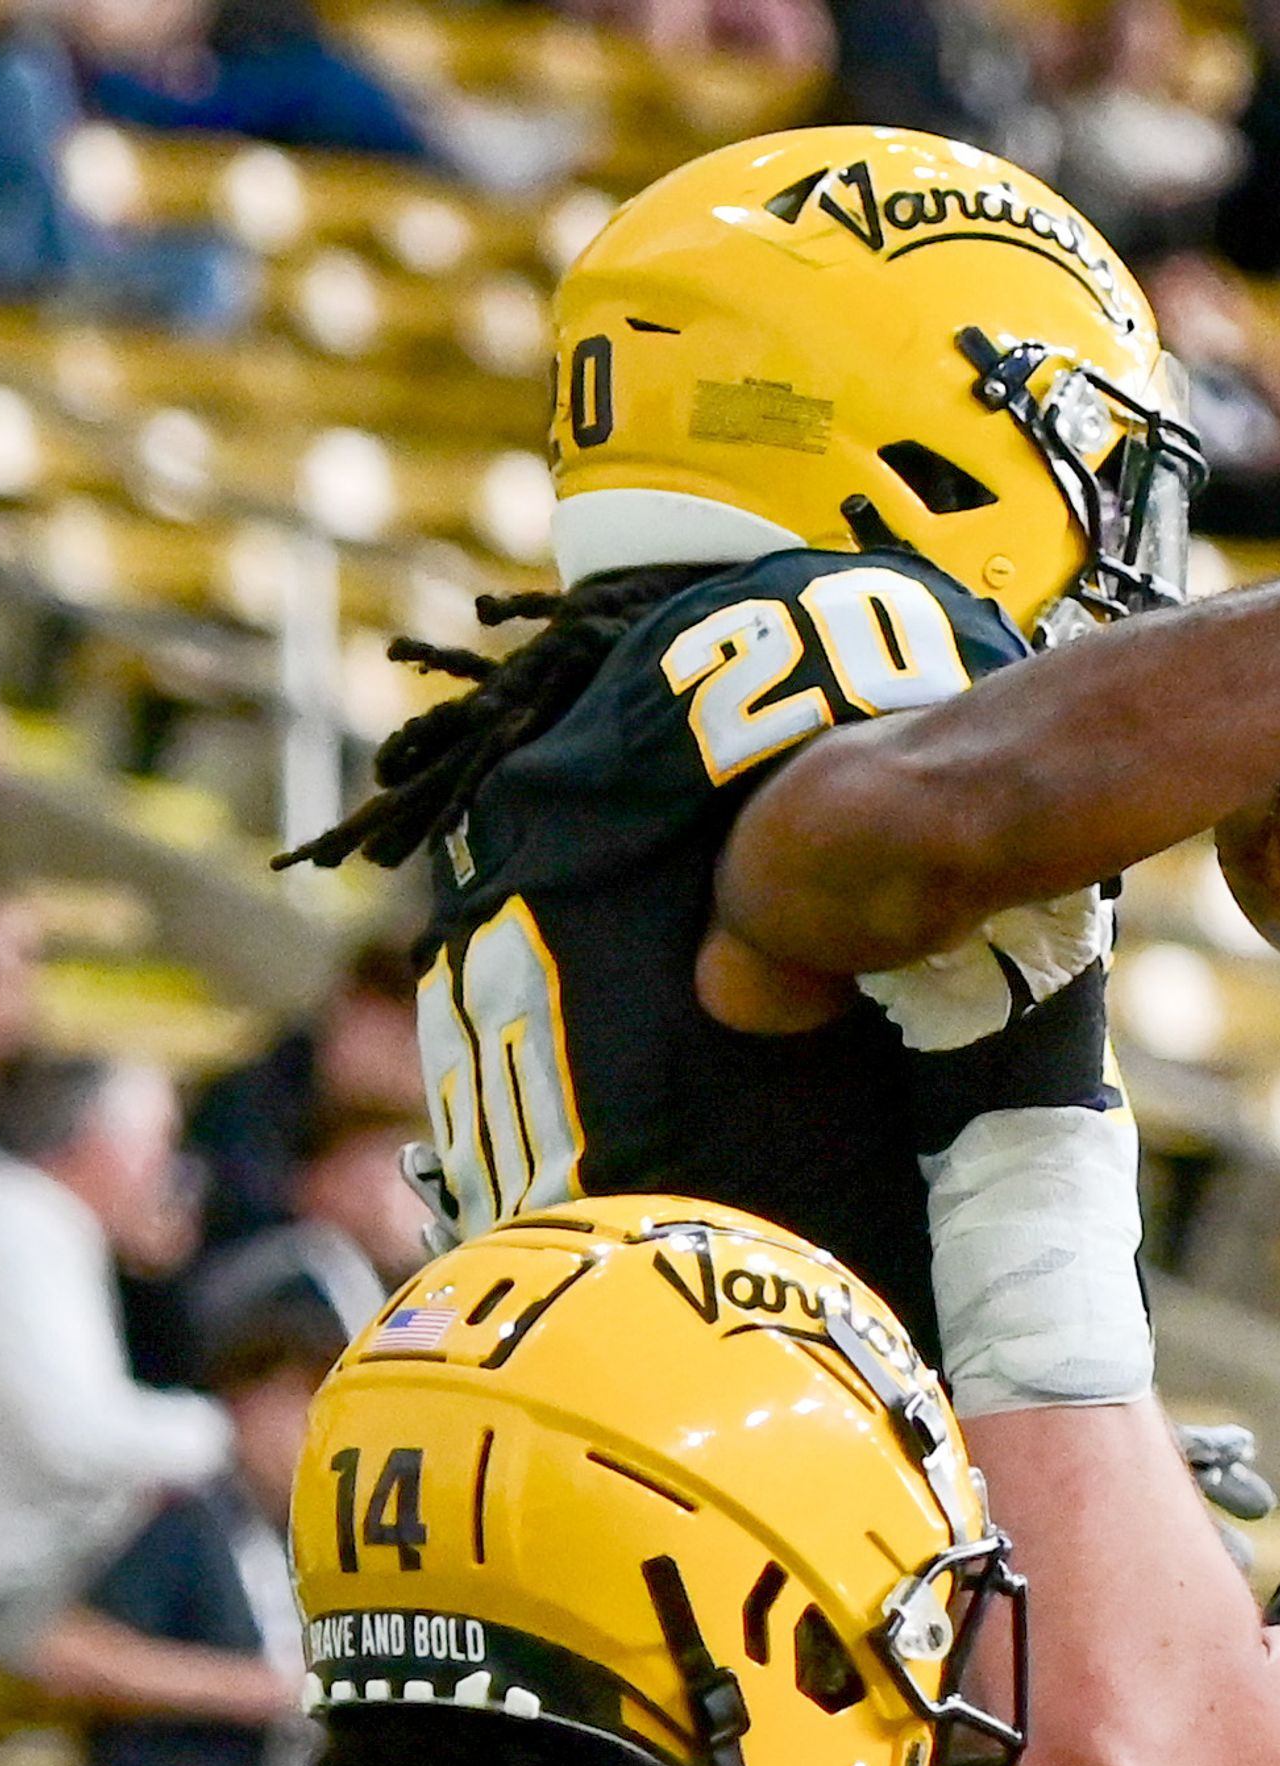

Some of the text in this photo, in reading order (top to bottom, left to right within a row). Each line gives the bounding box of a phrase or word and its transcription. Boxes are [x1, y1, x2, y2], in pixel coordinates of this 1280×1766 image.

[554, 333, 613, 449] 0
[660, 567, 971, 787] 20
[331, 1447, 427, 1574] 14
[361, 1613, 406, 1657] AND
[413, 1614, 486, 1663] BOLD
